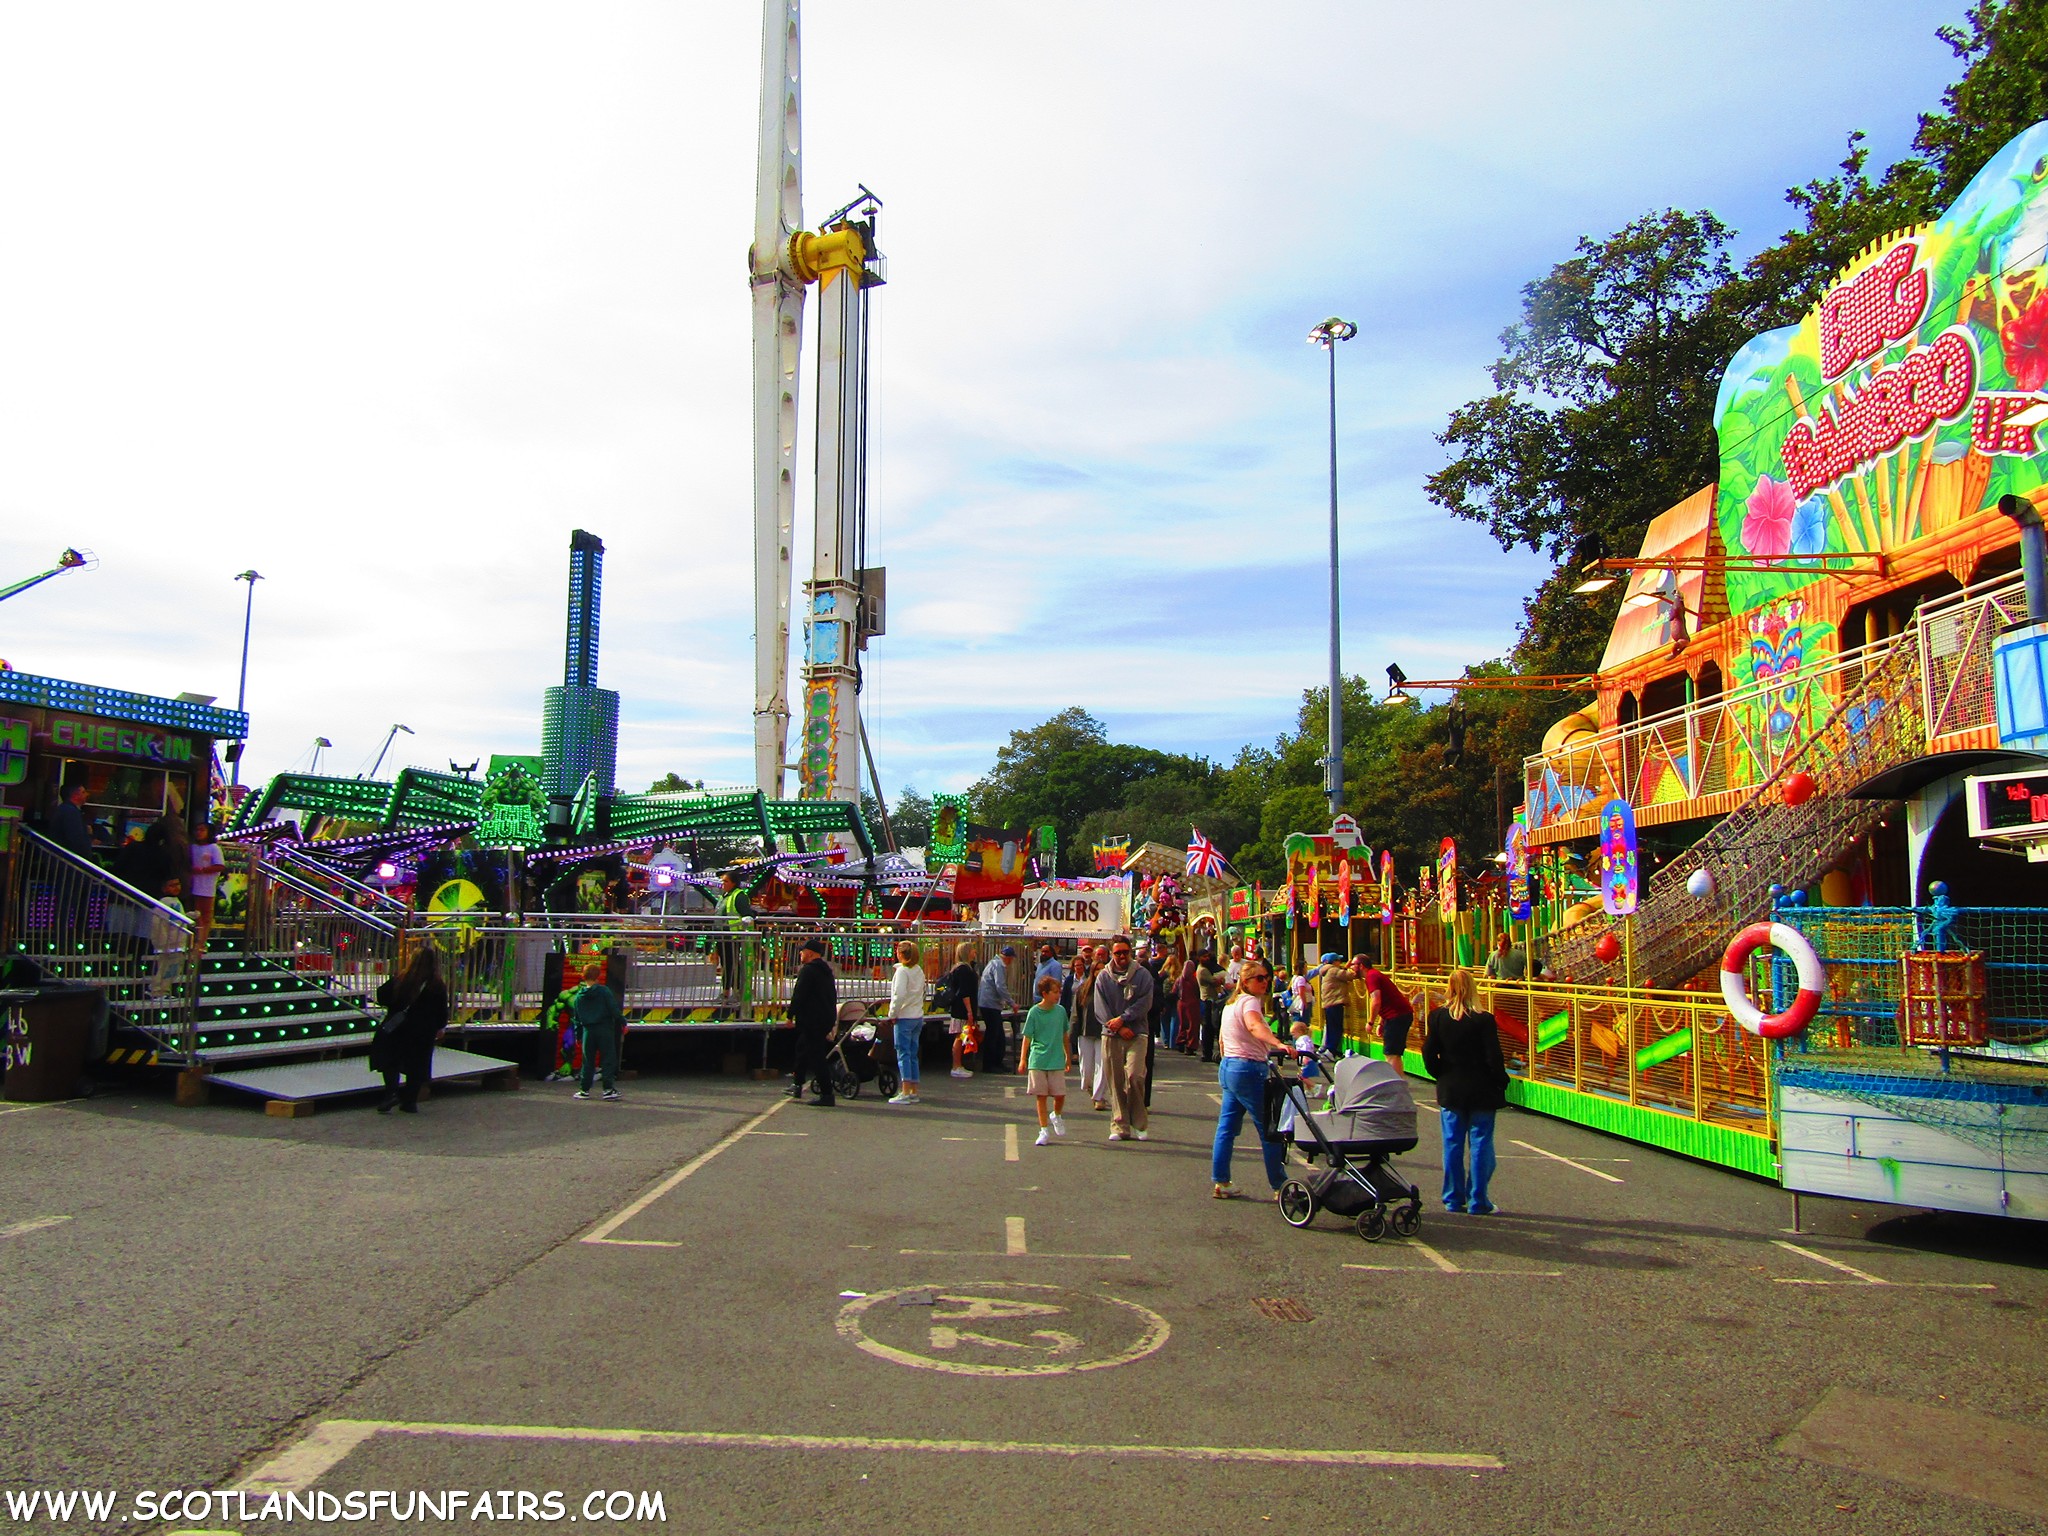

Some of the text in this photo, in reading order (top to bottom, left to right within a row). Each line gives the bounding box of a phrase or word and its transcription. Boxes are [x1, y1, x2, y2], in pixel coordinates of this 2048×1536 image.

[1820, 243, 1927, 380] BIG
[1780, 331, 1975, 500] BAMBOO
[52, 720, 192, 762] CHECK IN
[493, 803, 531, 821] THE
[480, 820, 541, 841] HULK
[1014, 897, 1100, 922] BURGERS
